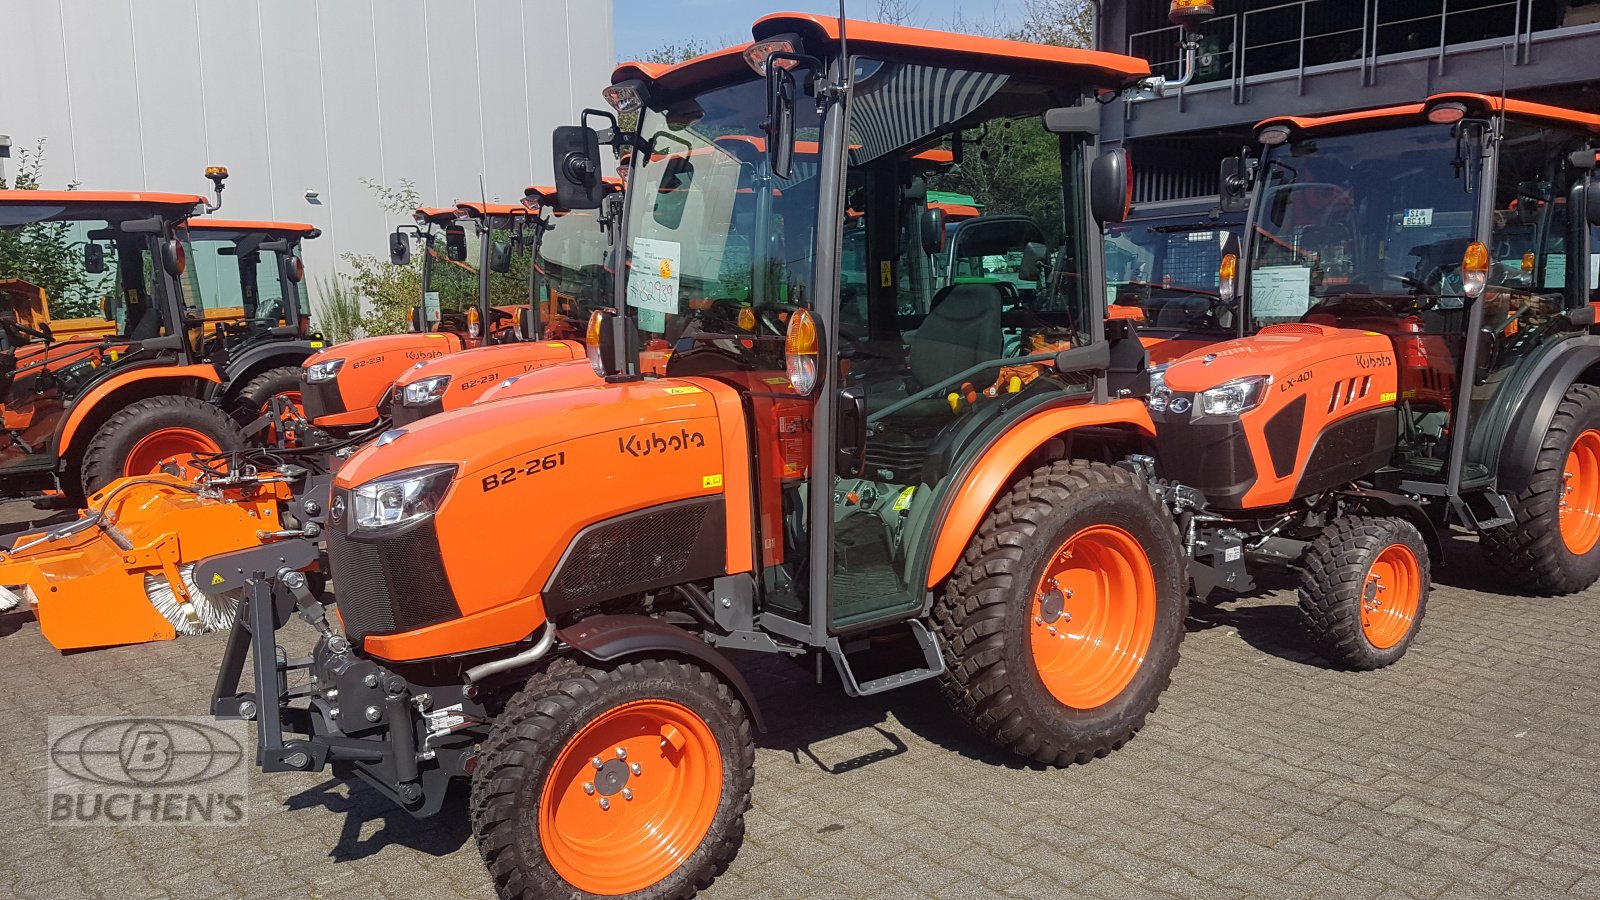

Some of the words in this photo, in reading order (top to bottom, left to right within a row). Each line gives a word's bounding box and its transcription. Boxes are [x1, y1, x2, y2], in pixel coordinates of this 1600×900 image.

[352, 355, 386, 370] B2-231
[405, 350, 443, 360] Kubota
[1355, 353, 1392, 369] Kubota
[461, 372, 500, 392] B2-231
[1280, 370, 1313, 393] LX-401
[618, 428, 705, 458] Kubota
[481, 451, 566, 493] B2-261
